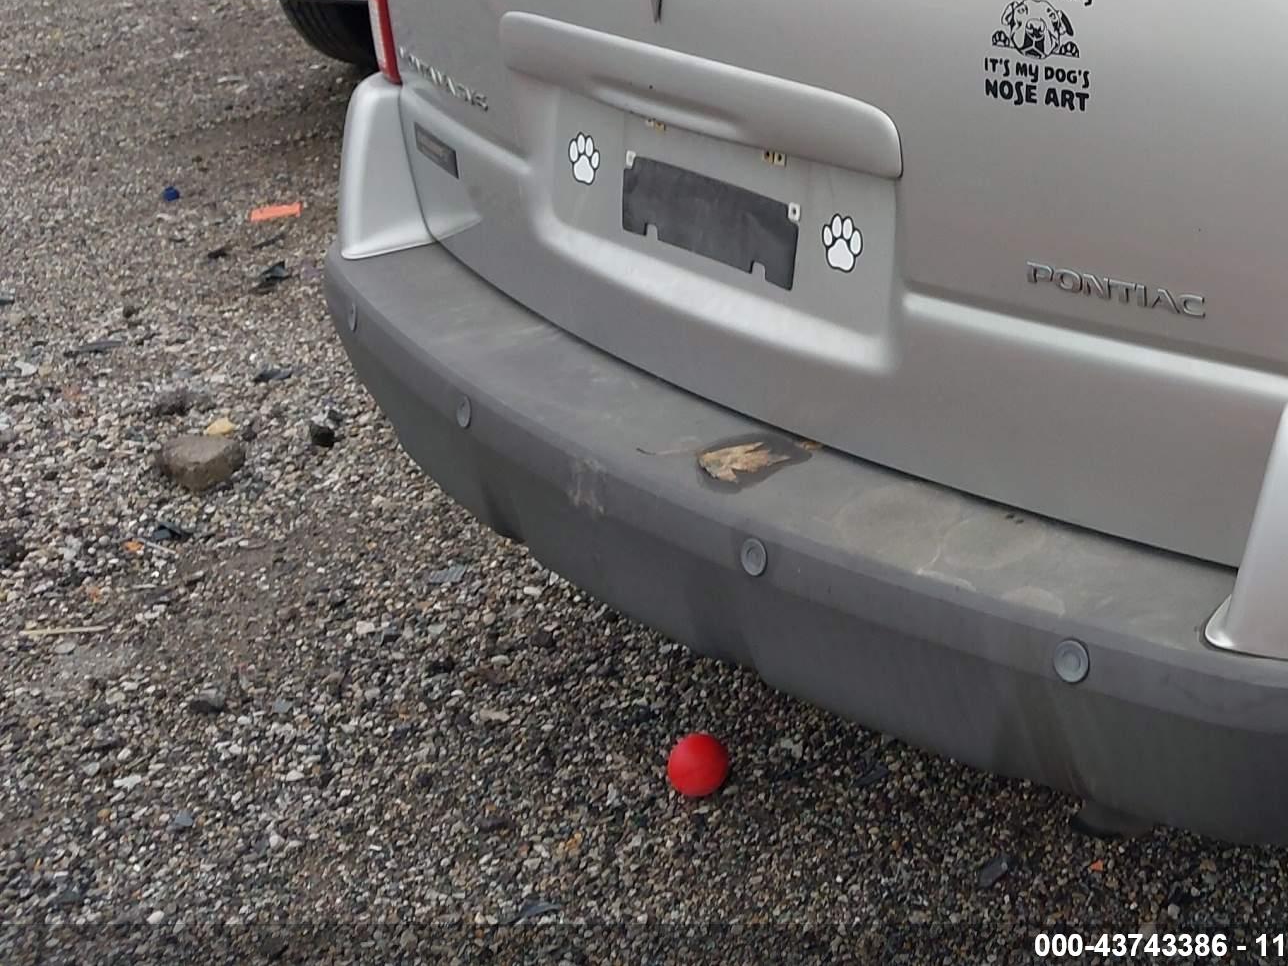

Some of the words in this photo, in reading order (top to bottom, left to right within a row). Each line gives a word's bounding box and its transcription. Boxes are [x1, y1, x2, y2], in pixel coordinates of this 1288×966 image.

[984, 57, 1010, 77] IT'S
[1044, 65, 1090, 89] DOG'S
[985, 79, 1038, 105] NOSE
[1045, 87, 1090, 111] ART
[1026, 260, 1206, 318] PONTIAC
